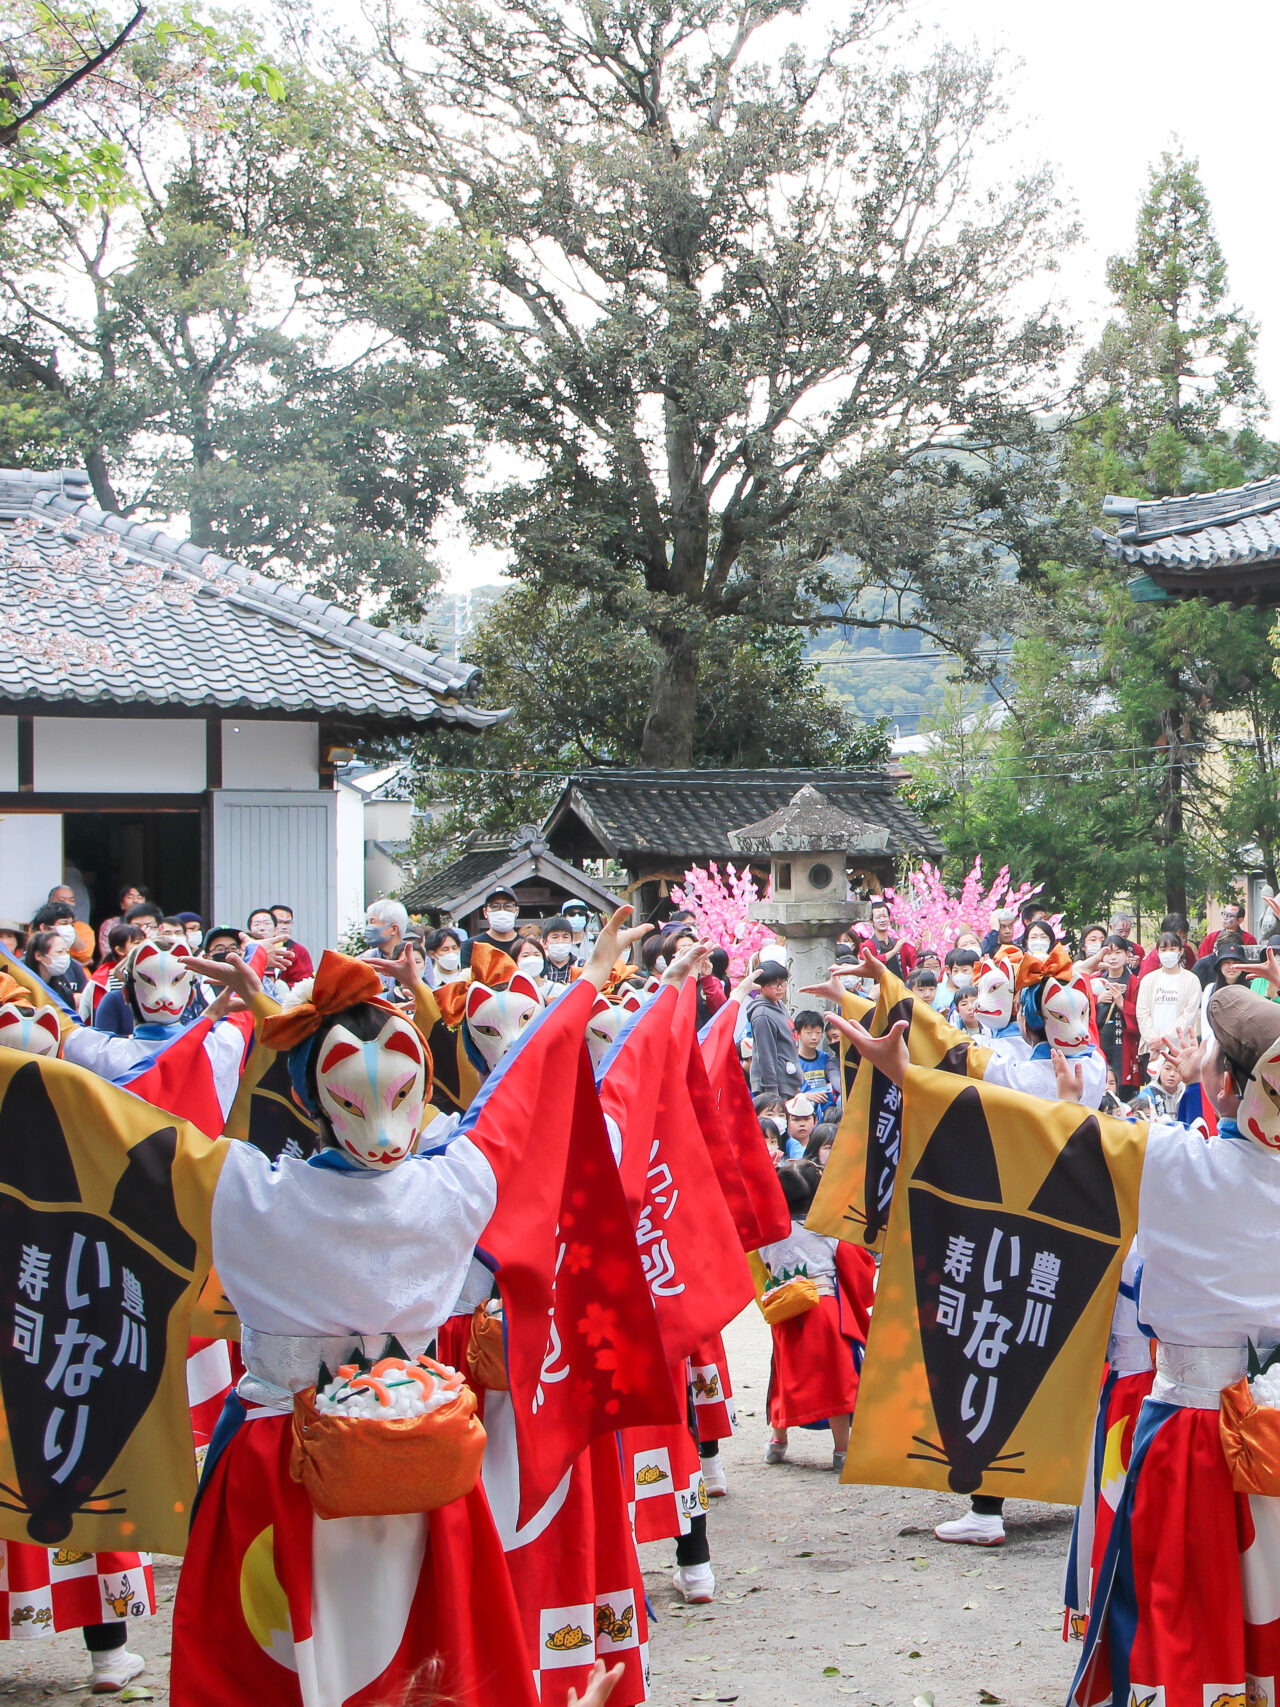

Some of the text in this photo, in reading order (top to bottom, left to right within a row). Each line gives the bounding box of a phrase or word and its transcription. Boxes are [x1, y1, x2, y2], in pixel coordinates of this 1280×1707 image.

[12, 1244, 51, 1364] 寿司
[111, 1265, 147, 1372] 豊川
[935, 1235, 976, 1336] 寿司
[960, 1227, 1021, 1444] いなり
[1015, 1250, 1062, 1347] 豊川
[44, 1232, 110, 1484] いなり
